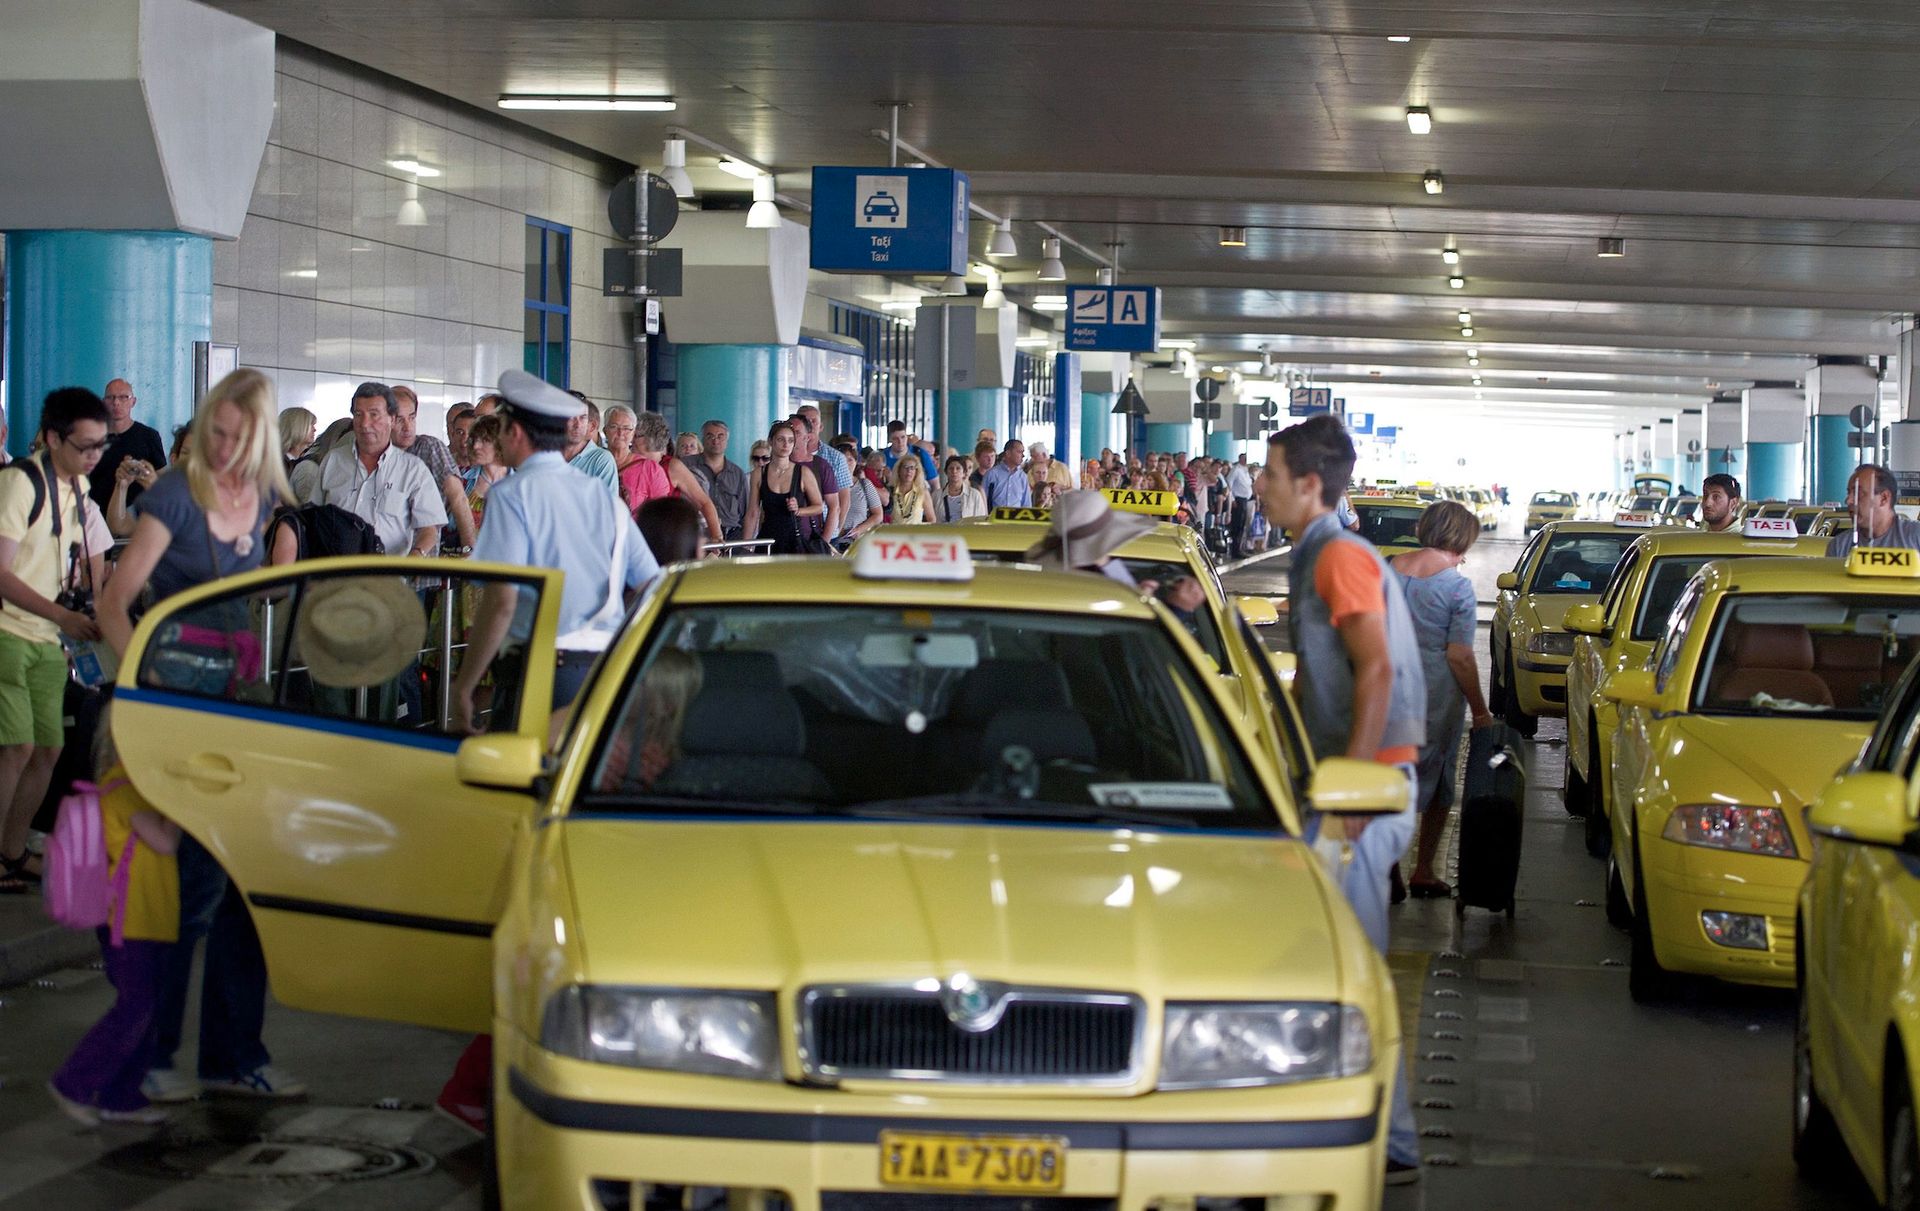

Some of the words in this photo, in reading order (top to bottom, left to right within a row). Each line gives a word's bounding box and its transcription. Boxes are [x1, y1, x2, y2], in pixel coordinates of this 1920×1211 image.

[870, 236, 891, 248] Ταξί
[870, 251, 889, 262] Taxi
[1120, 294, 1139, 321] A
[1110, 490, 1162, 506] TAXI
[998, 508, 1052, 521] TAX
[1618, 513, 1648, 523] ΤΑΞΙ
[1750, 520, 1791, 530] ΤΑΞΙ
[872, 539, 958, 562] ΤΑΞΙ
[1857, 551, 1911, 567] TAXI
